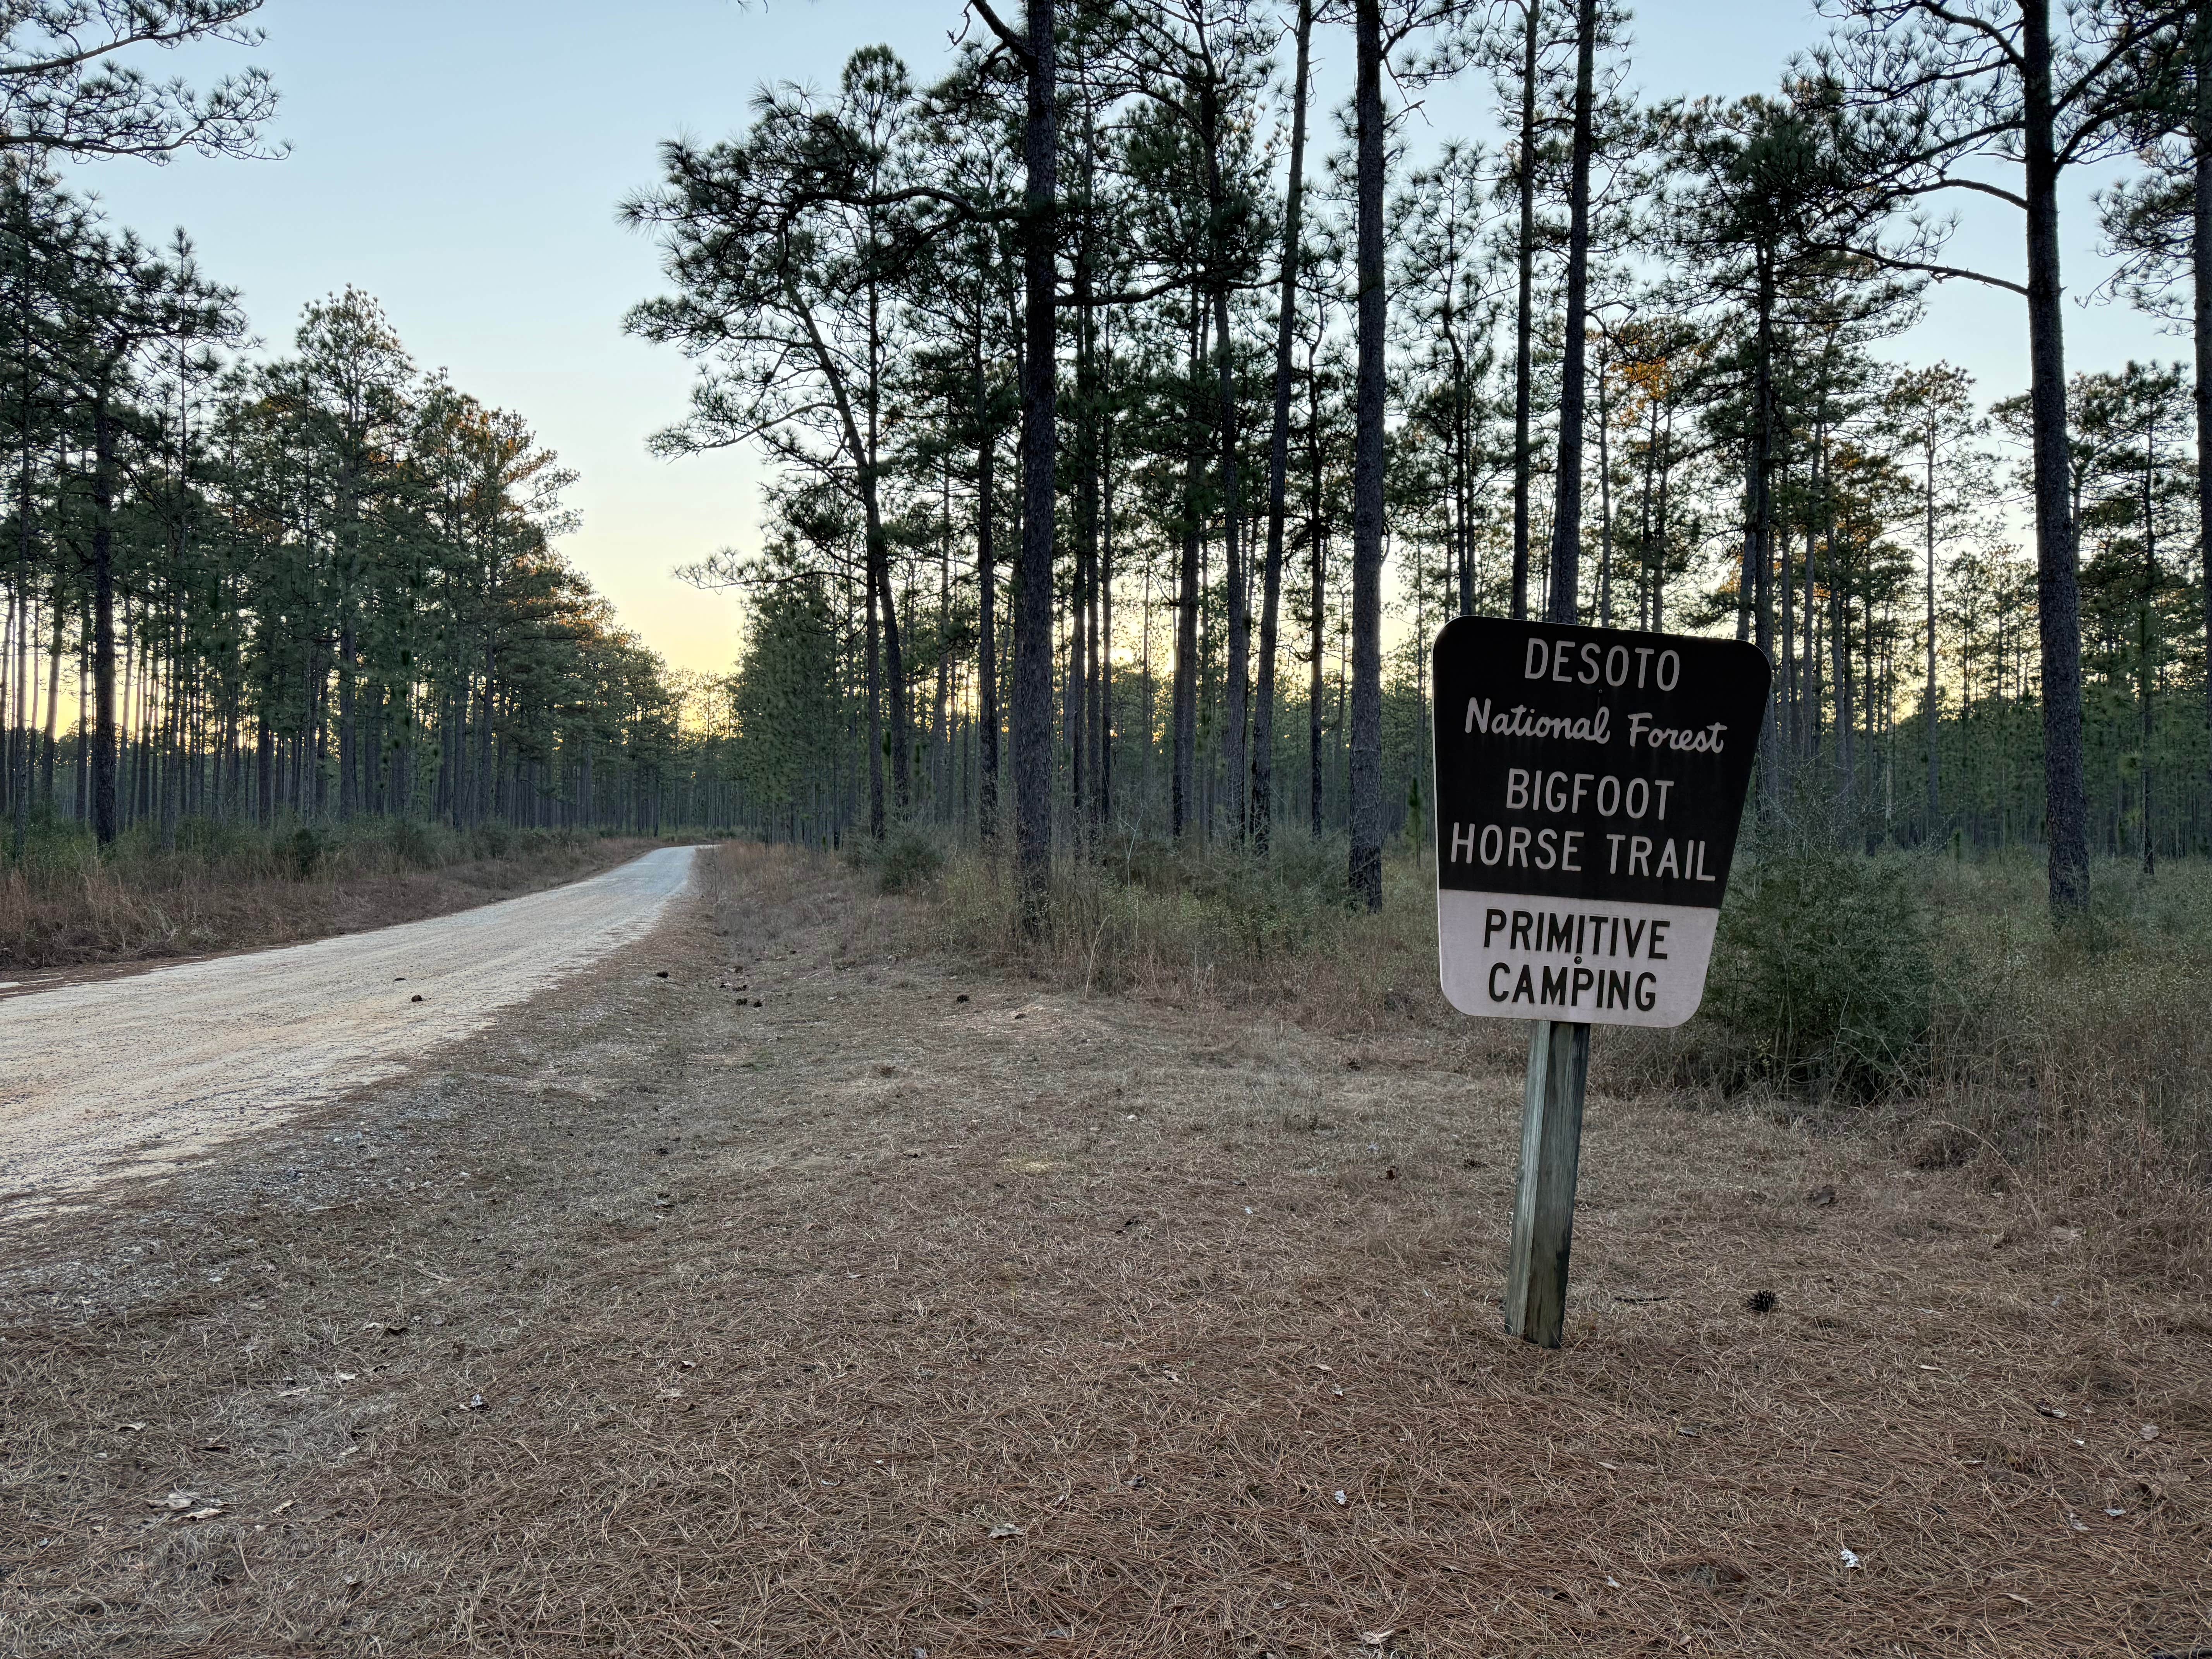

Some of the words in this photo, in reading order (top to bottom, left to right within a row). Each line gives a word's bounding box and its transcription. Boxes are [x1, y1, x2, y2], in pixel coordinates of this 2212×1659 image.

[1524, 638, 1681, 692] DESOTO
[1465, 697, 1611, 744] National
[1627, 712, 1728, 754] Forest
[1506, 768, 1674, 820] BIGFOOT
[1450, 822, 1585, 872] HORSE
[1606, 834, 1716, 881] TRAIL
[1484, 908, 1671, 960] PRIMITIVE
[1489, 962, 1657, 1012] CAMPING
